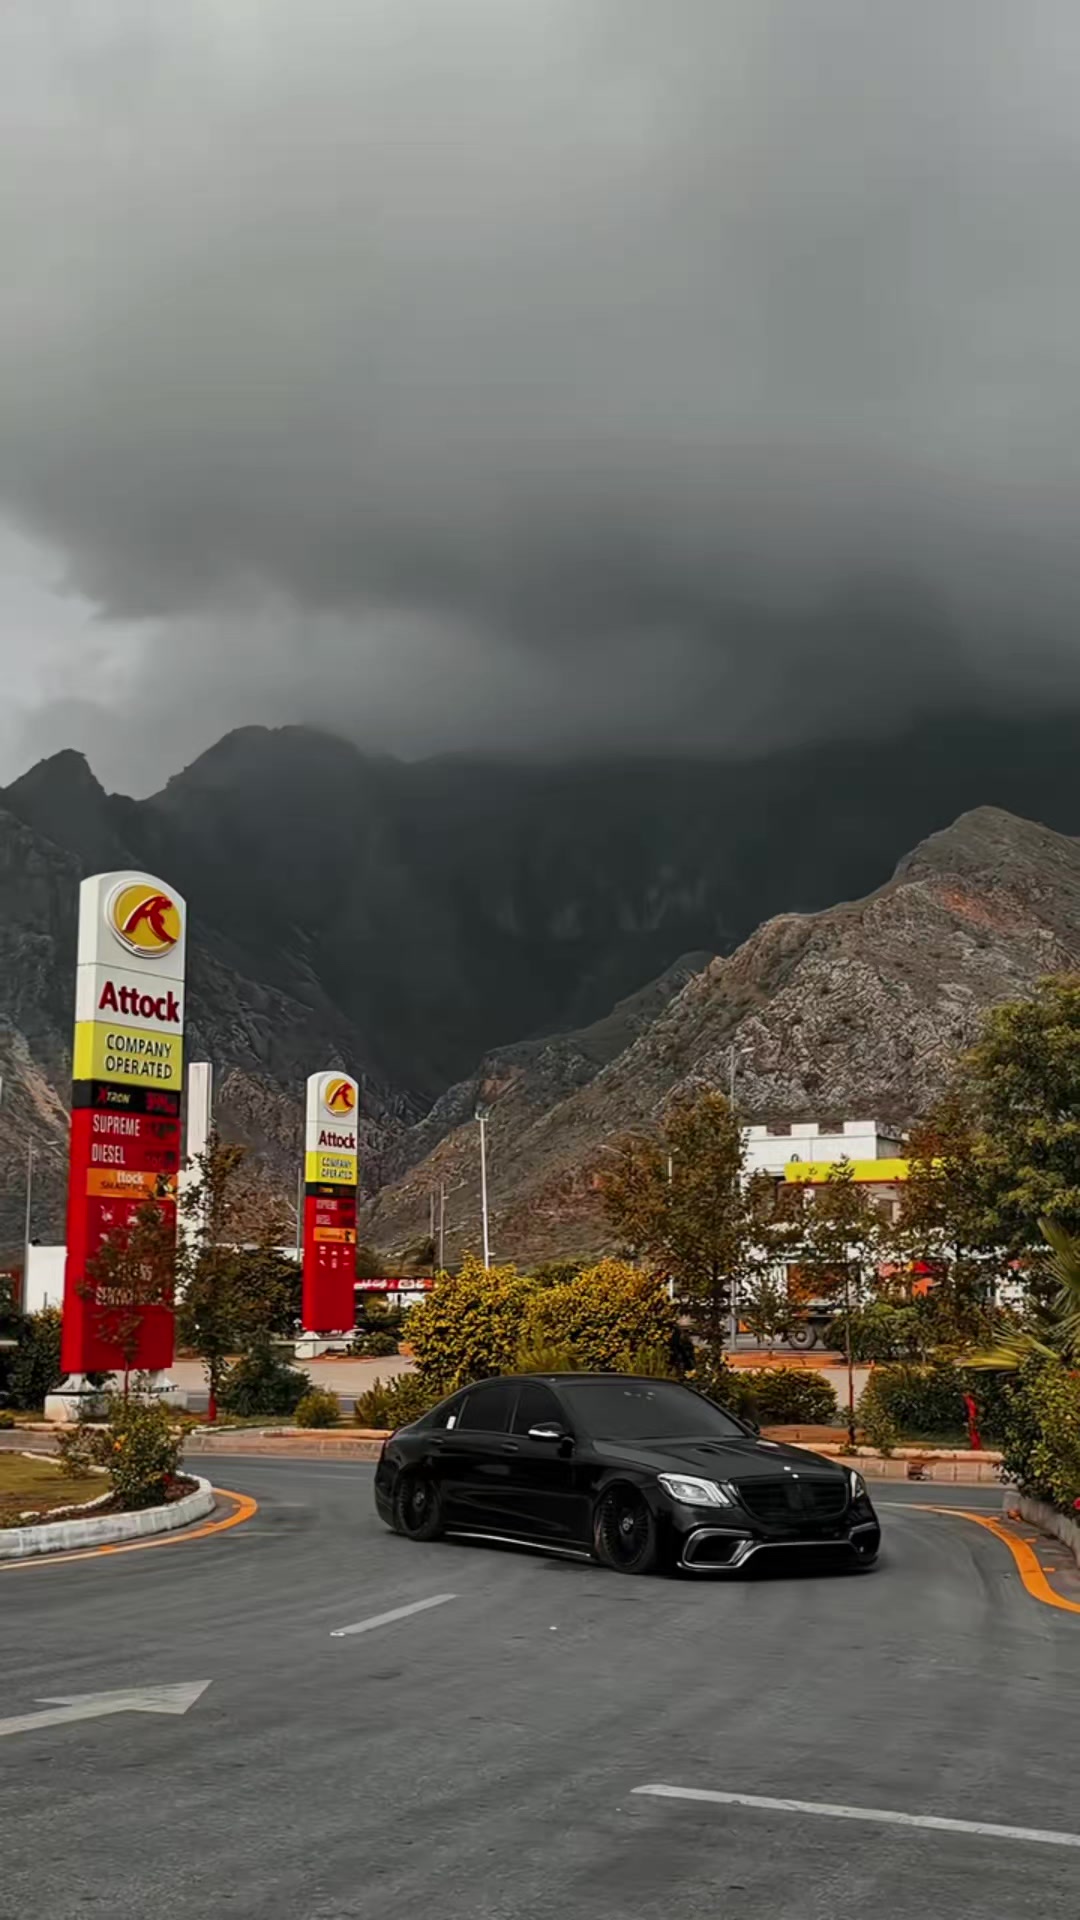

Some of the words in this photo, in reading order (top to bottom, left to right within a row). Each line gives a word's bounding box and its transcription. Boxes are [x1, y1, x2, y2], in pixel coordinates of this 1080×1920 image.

[98, 980, 180, 1024] Attock
[106, 1033, 172, 1058] COMPANY
[105, 1055, 173, 1079] OPERATED
[92, 1113, 141, 1137] SUPREME
[318, 1129, 356, 1150] Attock
[91, 1143, 126, 1165] DIESEL
